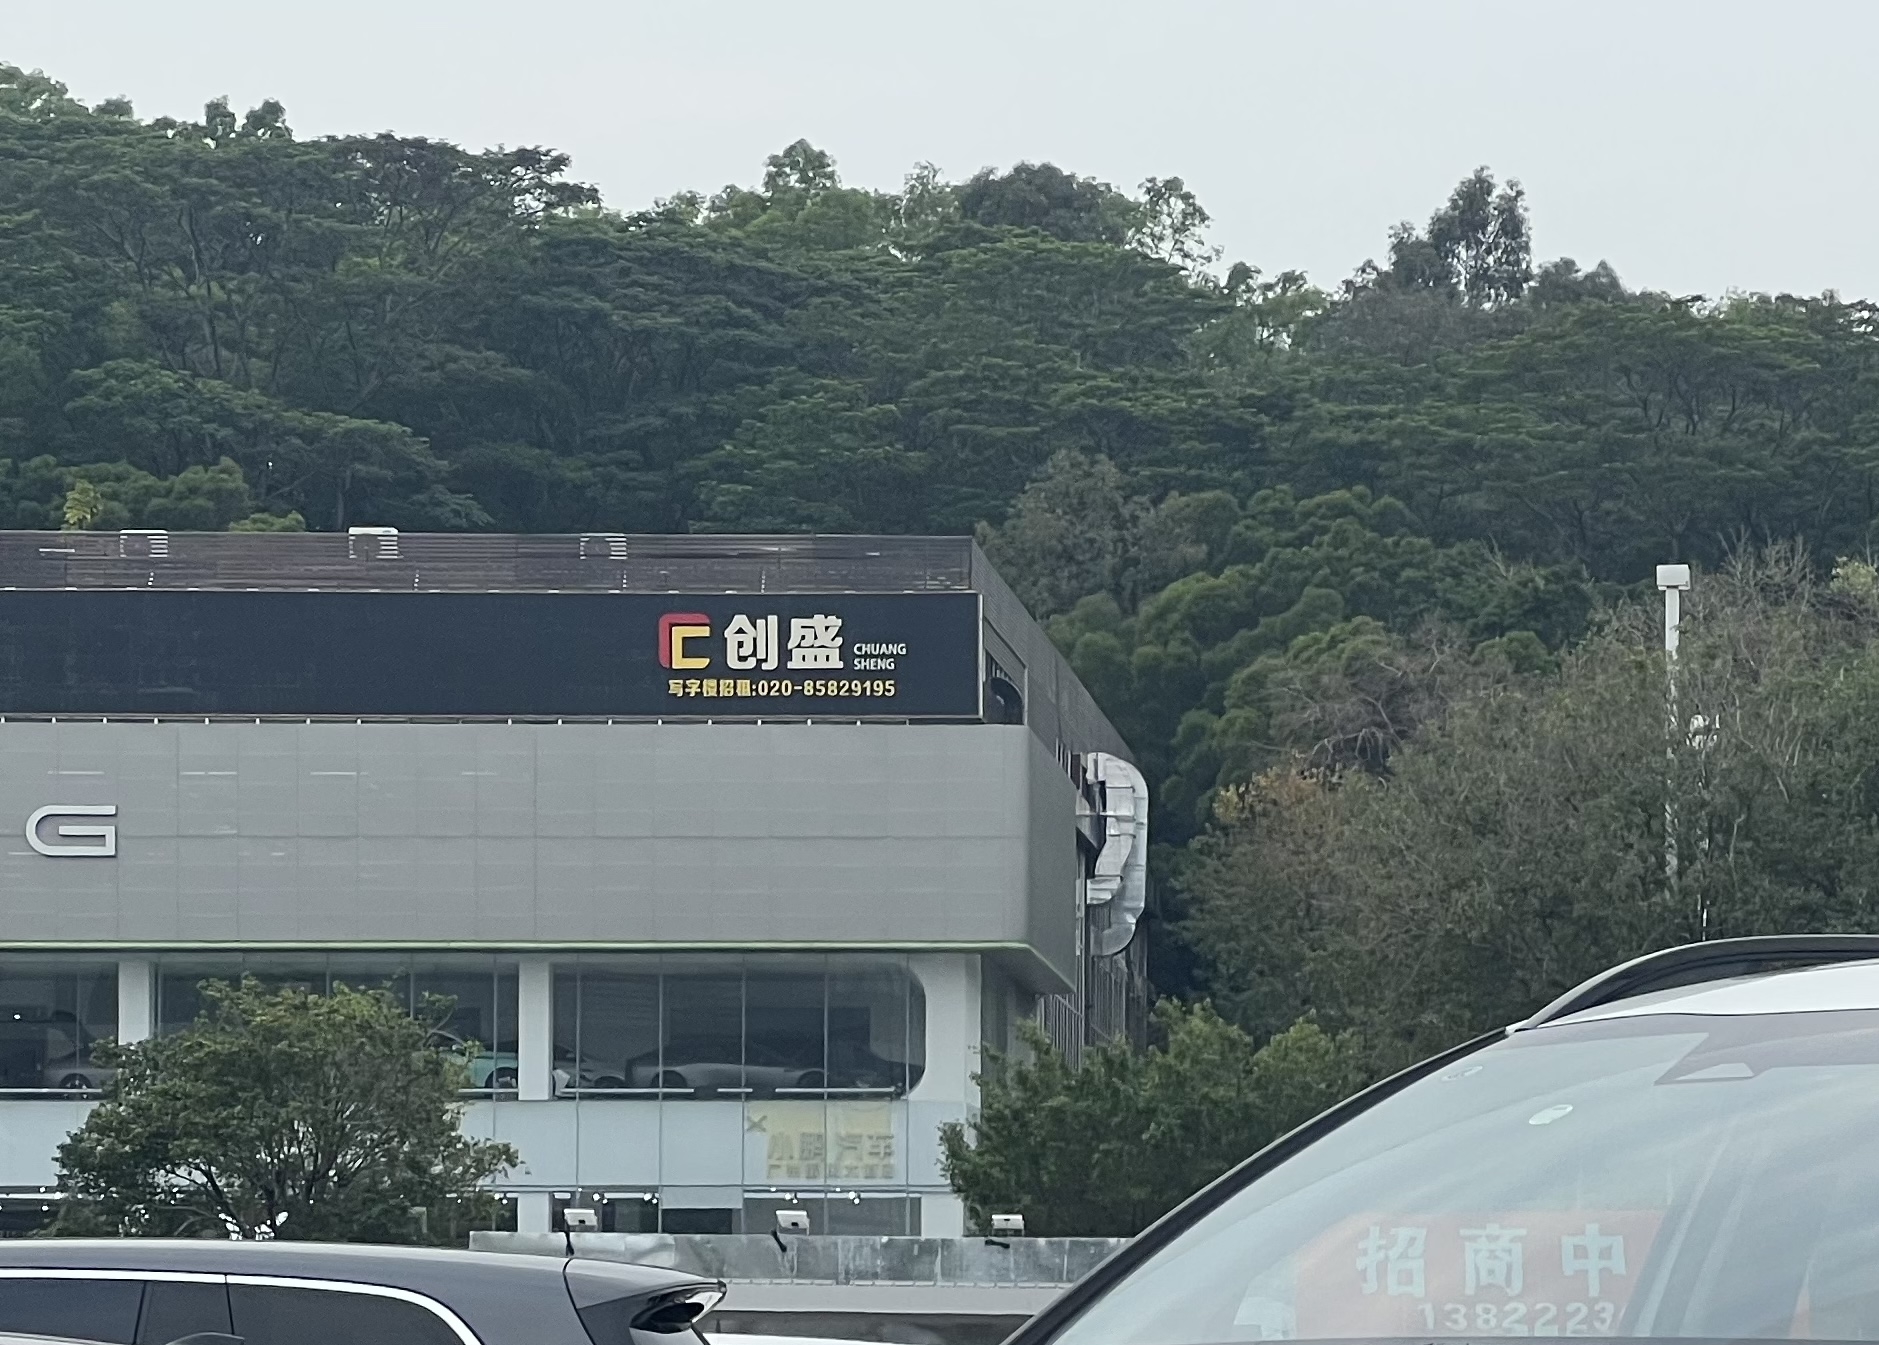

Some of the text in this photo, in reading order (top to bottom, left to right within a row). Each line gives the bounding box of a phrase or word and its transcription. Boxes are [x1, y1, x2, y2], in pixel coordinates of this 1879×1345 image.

[724, 613, 844, 671] 创盛
[853, 643, 907, 656] CHUANG
[853, 657, 895, 671] SHENG
[26, 804, 116, 856] G
[1356, 1222, 1627, 1298] 招商中
